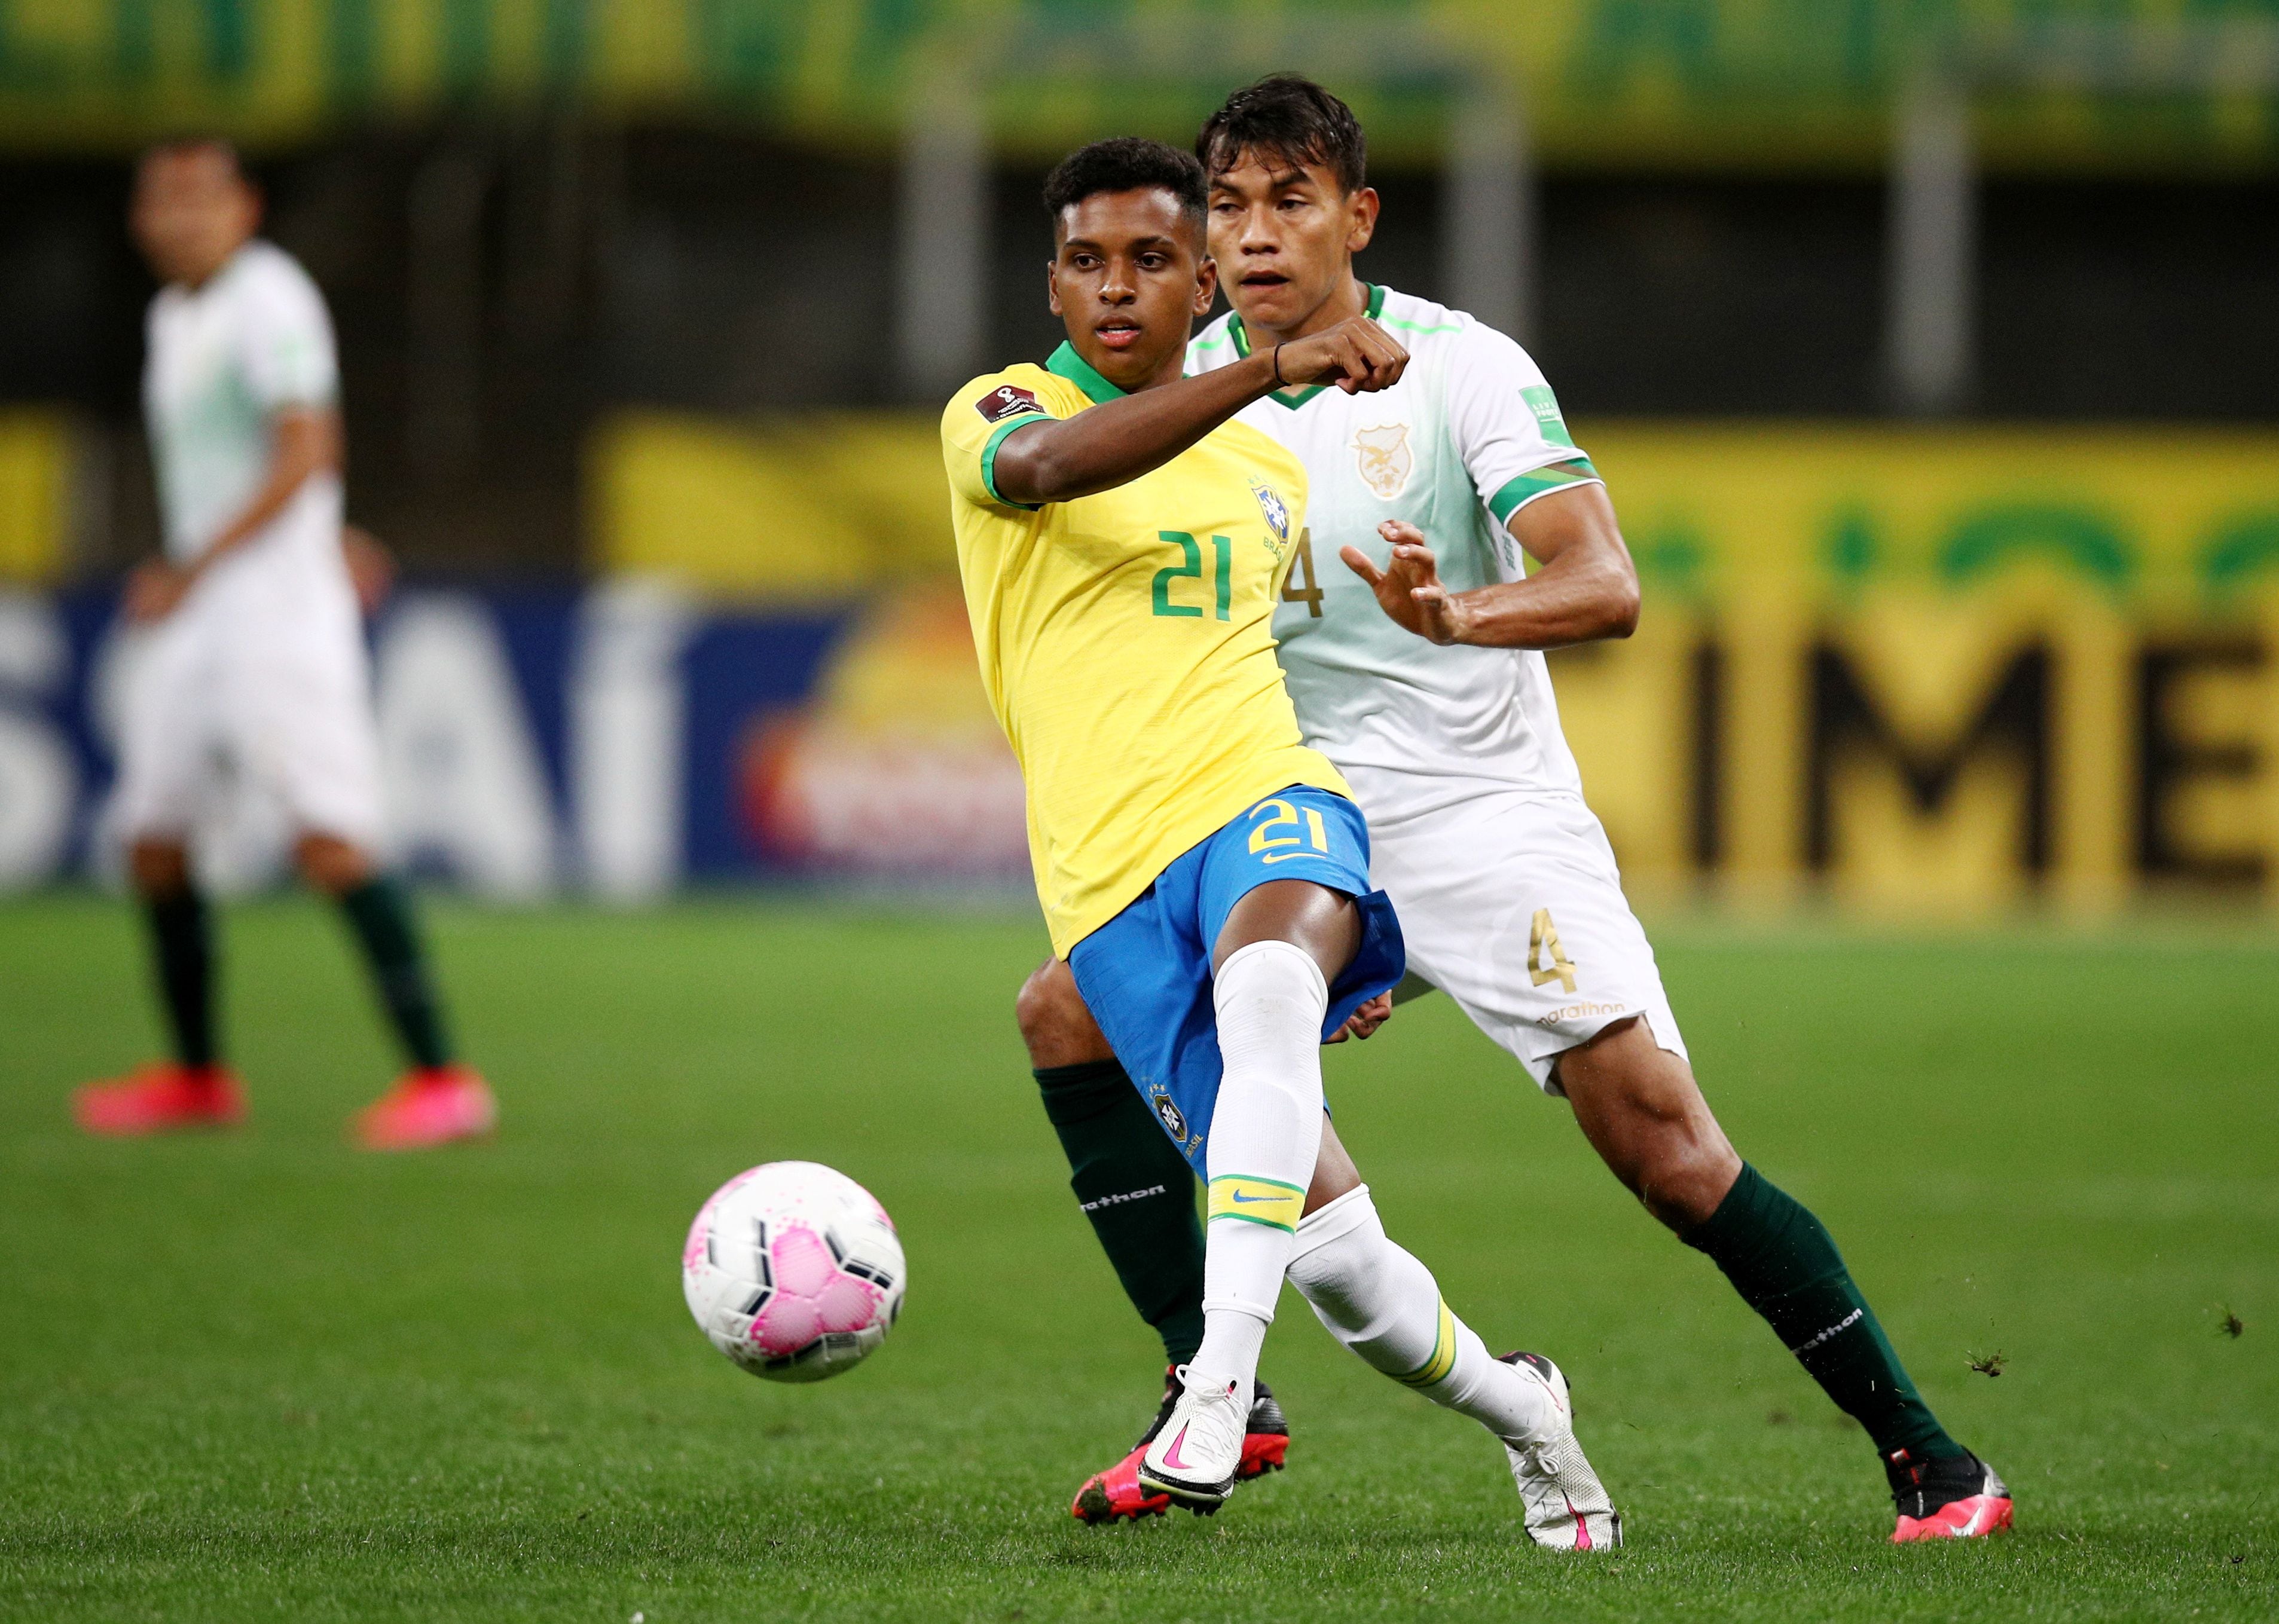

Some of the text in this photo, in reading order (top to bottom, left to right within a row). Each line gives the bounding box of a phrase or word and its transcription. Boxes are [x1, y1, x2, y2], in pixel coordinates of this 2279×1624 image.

[1151, 530, 1232, 622] 21
[1281, 527, 1324, 617] 4
[1550, 628, 2272, 883] IME
[1248, 799, 1328, 855] 21
[1528, 907, 1577, 995] 4
